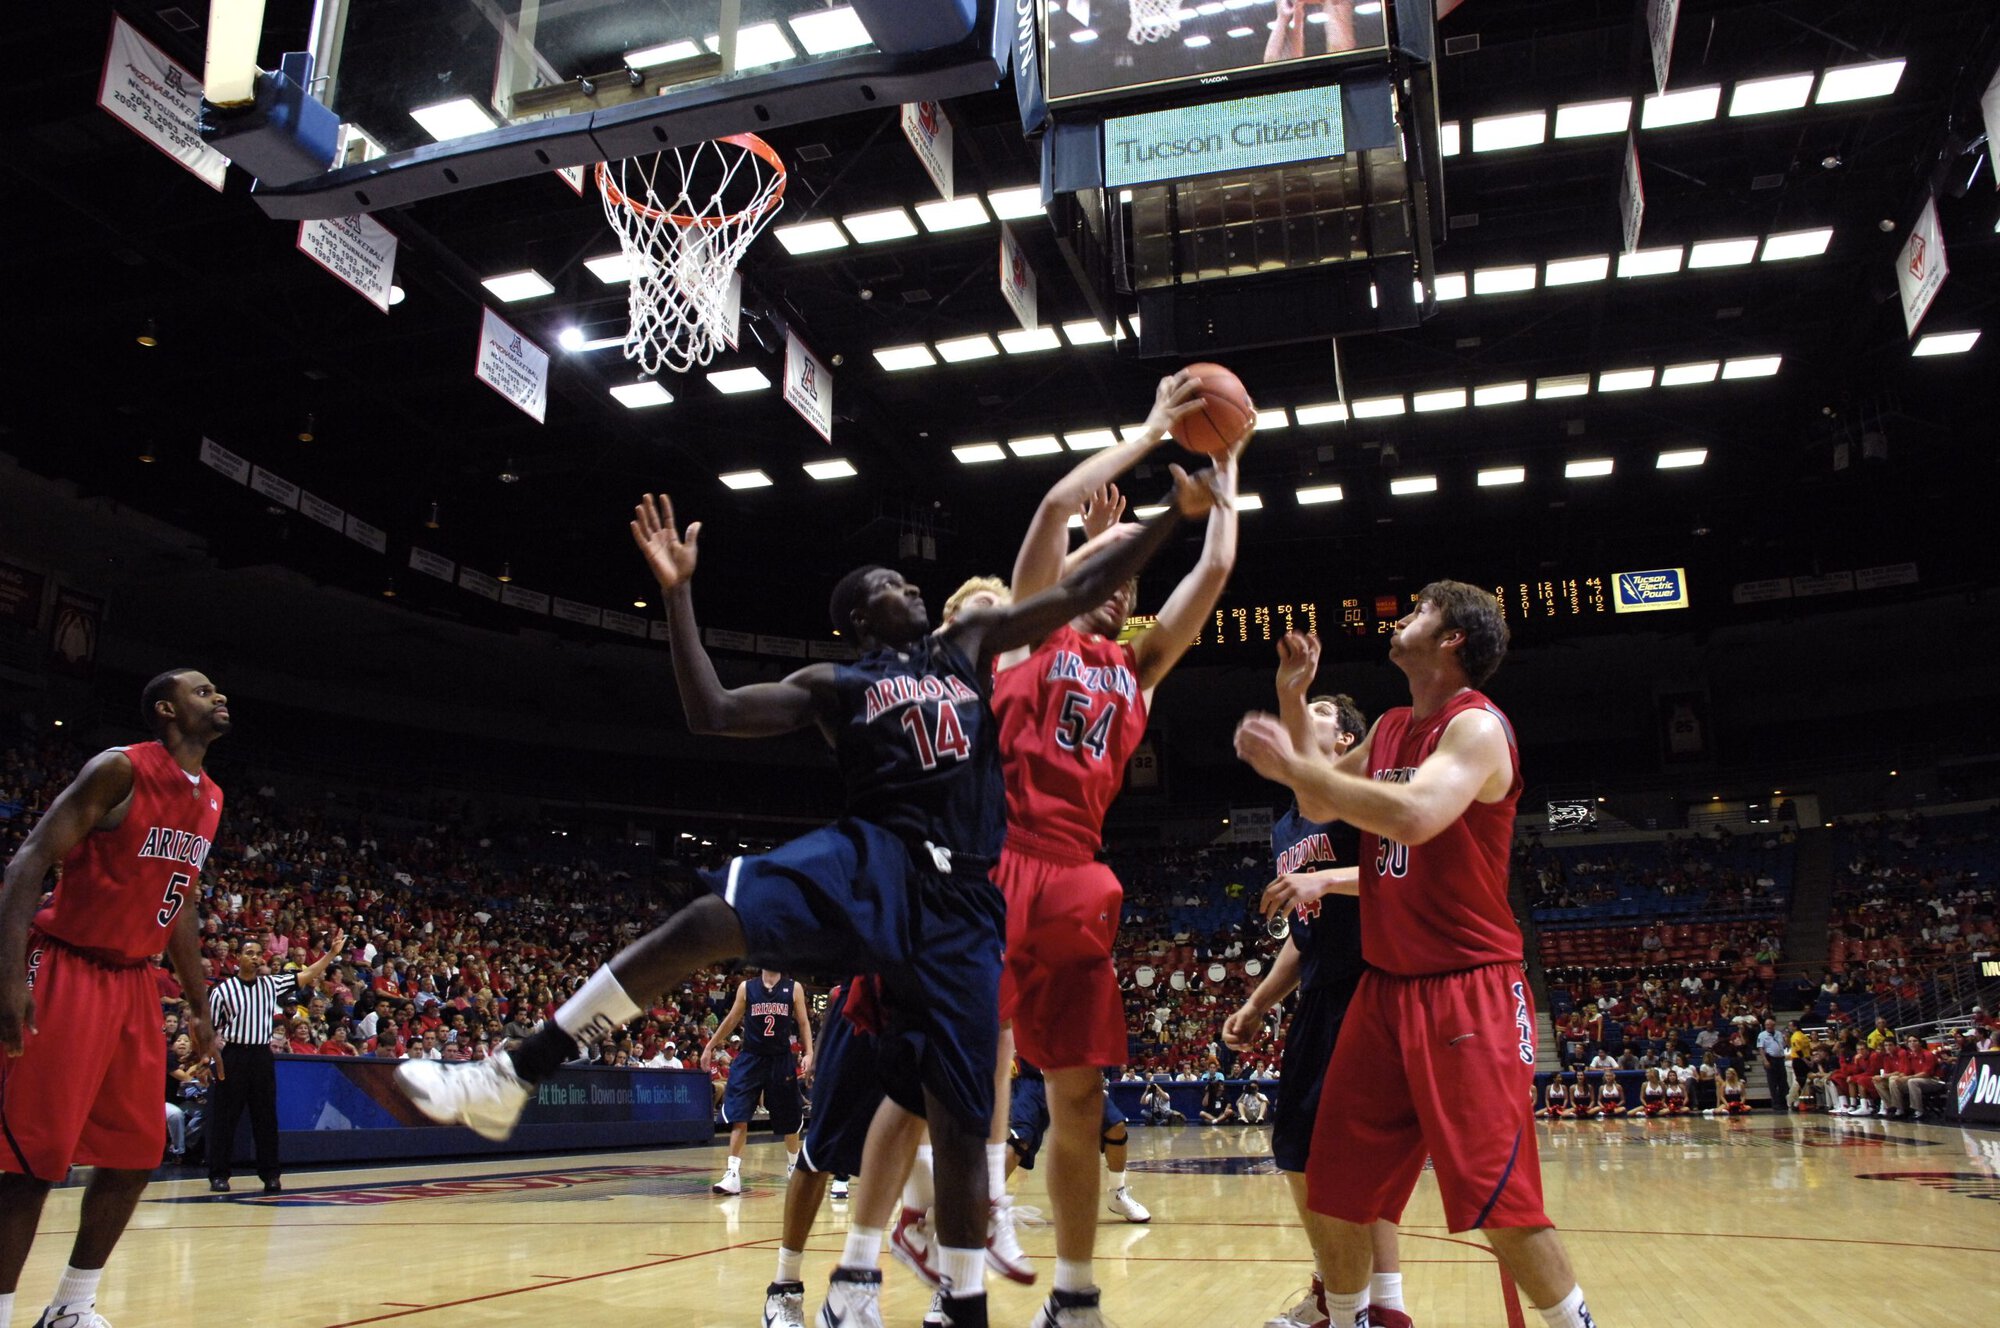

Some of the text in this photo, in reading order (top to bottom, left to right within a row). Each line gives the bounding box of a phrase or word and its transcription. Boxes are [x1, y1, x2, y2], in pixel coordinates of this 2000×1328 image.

[127, 78, 151, 102] NCAA
[113, 89, 138, 113] 2005
[143, 111, 165, 133] 2006
[130, 92, 152, 115] 2002
[156, 113, 179, 134] 2003
[1115, 115, 1331, 165] Tucson Citizen
[318, 222, 381, 273] NCAA TOURNAMENT
[321, 234, 338, 252] 1992
[334, 262, 352, 279] 2000
[1585, 577, 1602, 586] 44
[1632, 575, 1667, 585] Tucson
[1637, 580, 1674, 592] Electric
[1342, 599, 1358, 608] RED
[1641, 590, 1676, 599] Power
[1232, 608, 1247, 618] 20
[1255, 606, 1270, 616] 34
[1277, 604, 1293, 614] 50
[1301, 603, 1316, 613] 54
[901, 699, 971, 771] 14
[1055, 690, 1118, 762] 54
[1135, 756, 1153, 769] 32
[157, 872, 191, 928] 5
[750, 1003, 790, 1017] ARIZONA
[763, 1015, 775, 1037] 2
[538, 1084, 690, 1105] At the line. Down one. Two ticks left.
